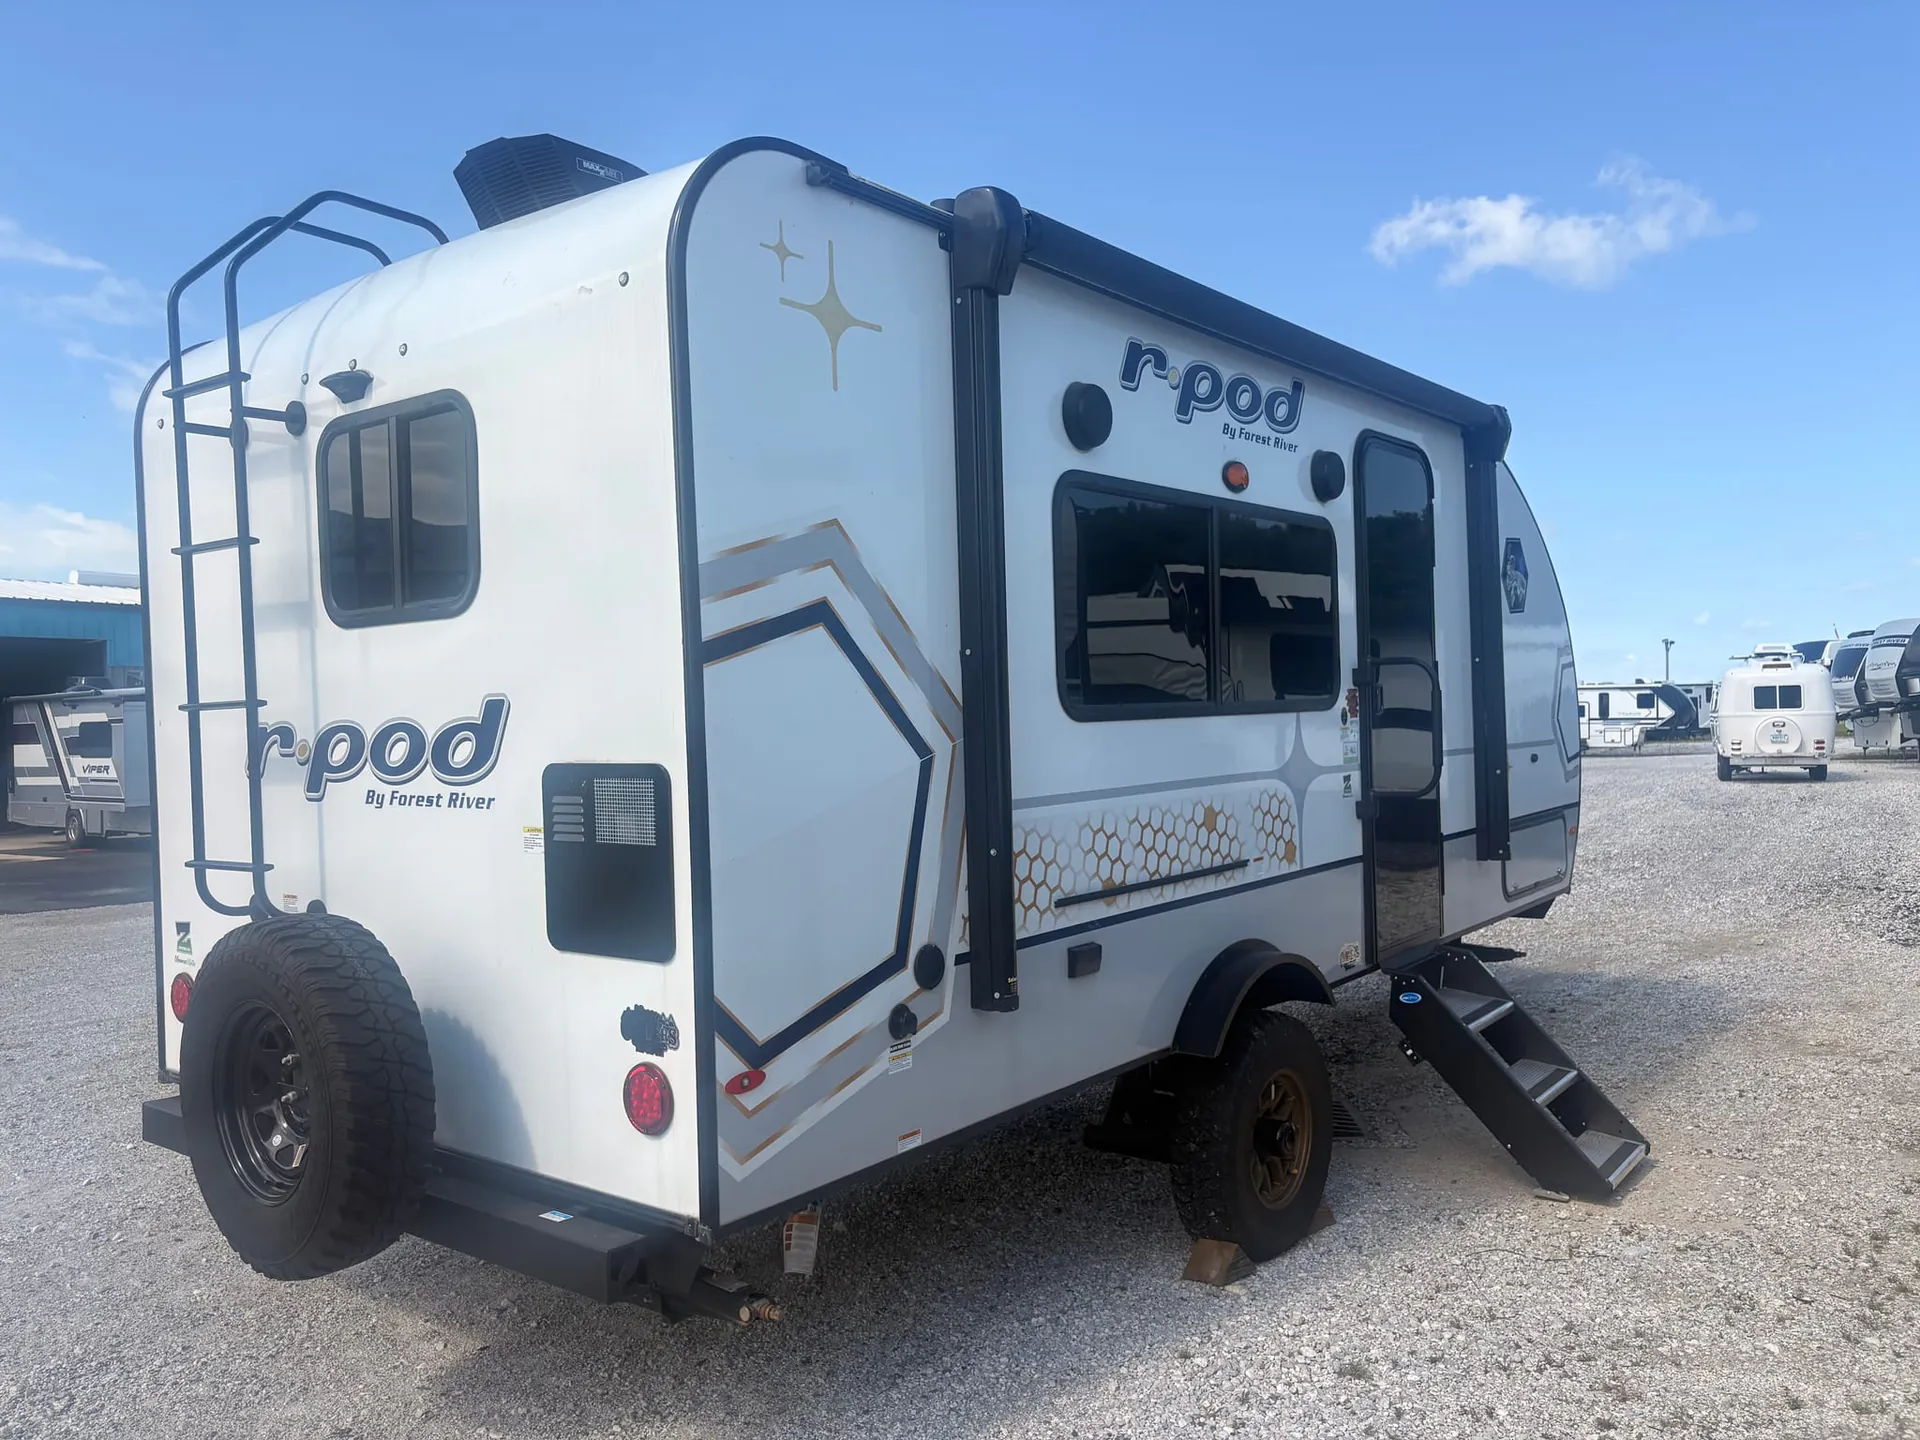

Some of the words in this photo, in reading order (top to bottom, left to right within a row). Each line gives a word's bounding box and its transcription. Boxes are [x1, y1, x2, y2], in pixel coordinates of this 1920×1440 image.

[1222, 422, 1237, 440] By
[1238, 427, 1272, 447] Forest
[1273, 436, 1299, 453] River
[81, 764, 111, 775] VIPER
[365, 789, 384, 809] By
[389, 790, 443, 808] Forest
[447, 792, 496, 810] River
